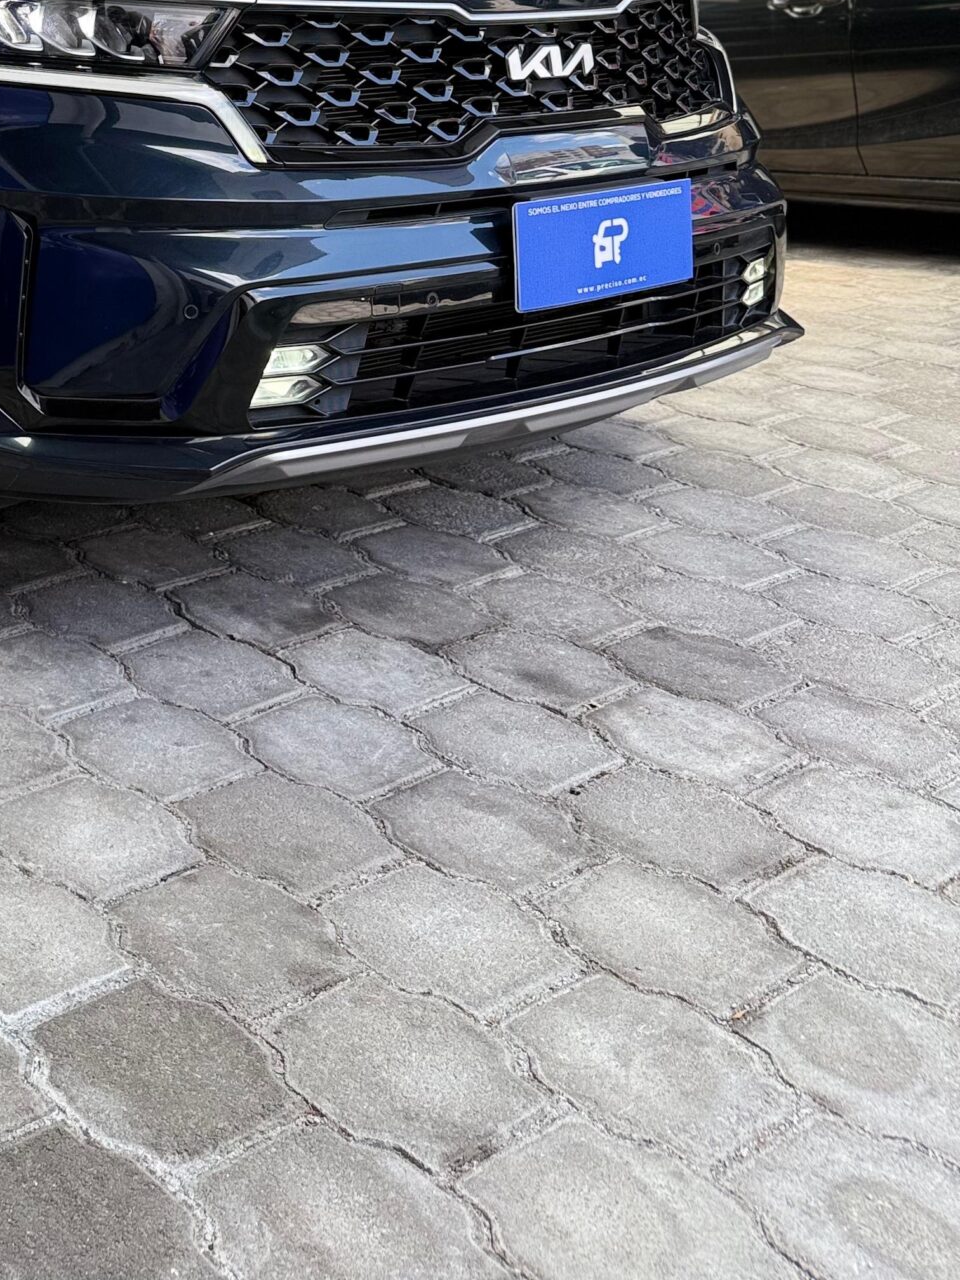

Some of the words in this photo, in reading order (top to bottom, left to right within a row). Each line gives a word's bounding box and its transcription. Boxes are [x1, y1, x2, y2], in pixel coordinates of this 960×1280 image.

[505, 43, 594, 80] KIA
[528, 206, 552, 217] SOMOS
[552, 204, 560, 214] EL
[560, 202, 578, 212] NEXO
[578, 199, 598, 210] ENTRE
[599, 193, 641, 207] COMPRADORES
[645, 187, 682, 199] VENDEDORES
[576, 275, 647, 294] www.preciso.com.ec
